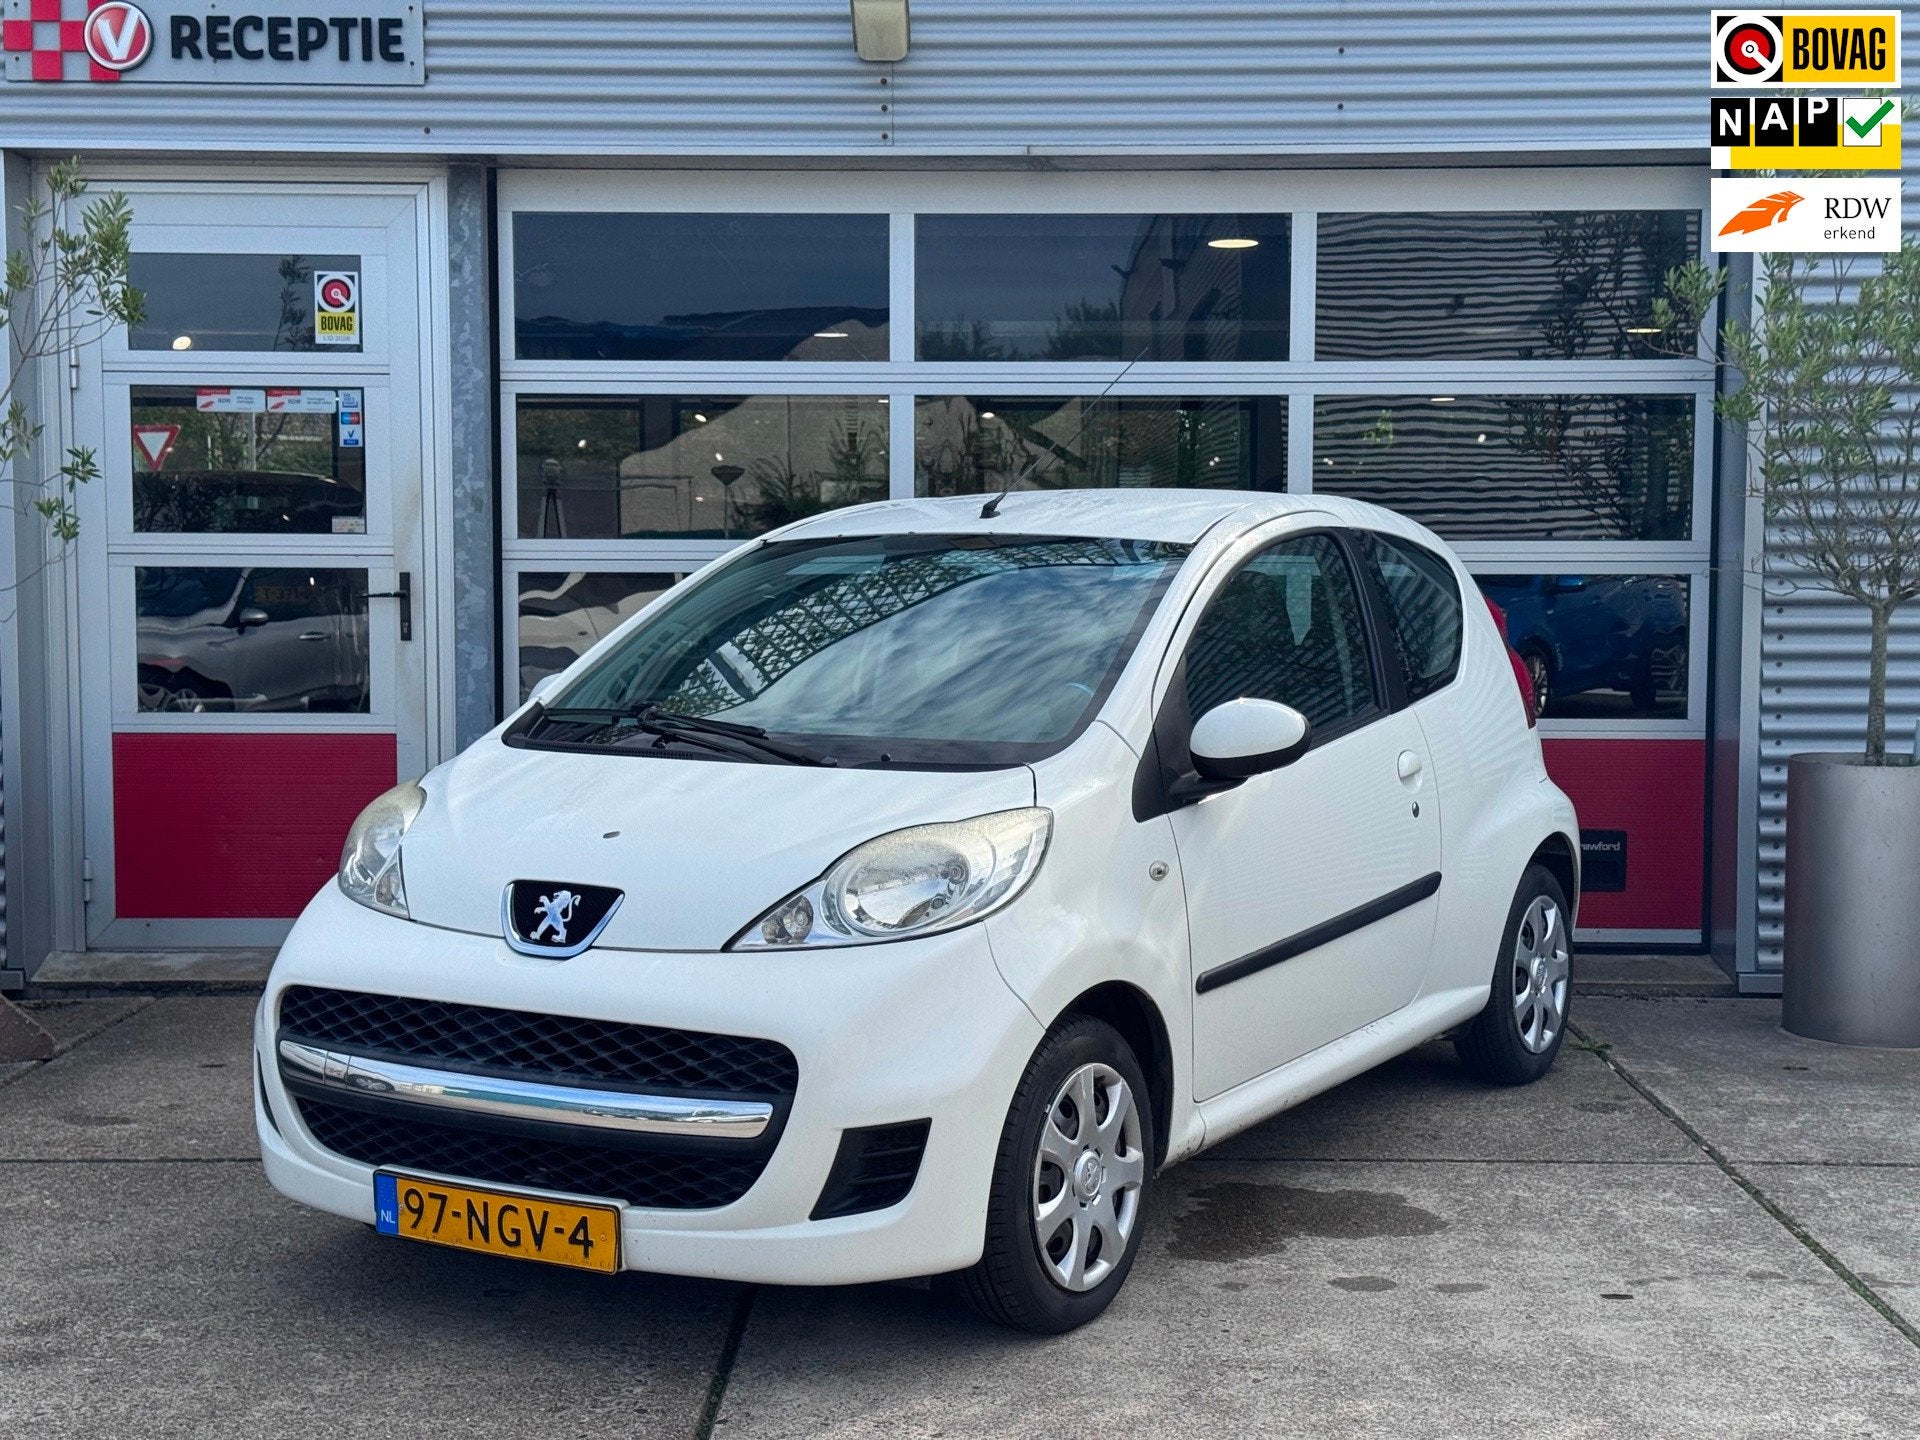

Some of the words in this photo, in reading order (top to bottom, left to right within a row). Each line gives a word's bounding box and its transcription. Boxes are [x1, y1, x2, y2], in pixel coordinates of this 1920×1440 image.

[169, 15, 406, 62] RECEPTIE
[320, 315, 354, 332] BOVAG
[1580, 841, 1621, 851] rawford
[380, 1210, 396, 1224] NL
[403, 1188, 594, 1259] 97-NGV-4
